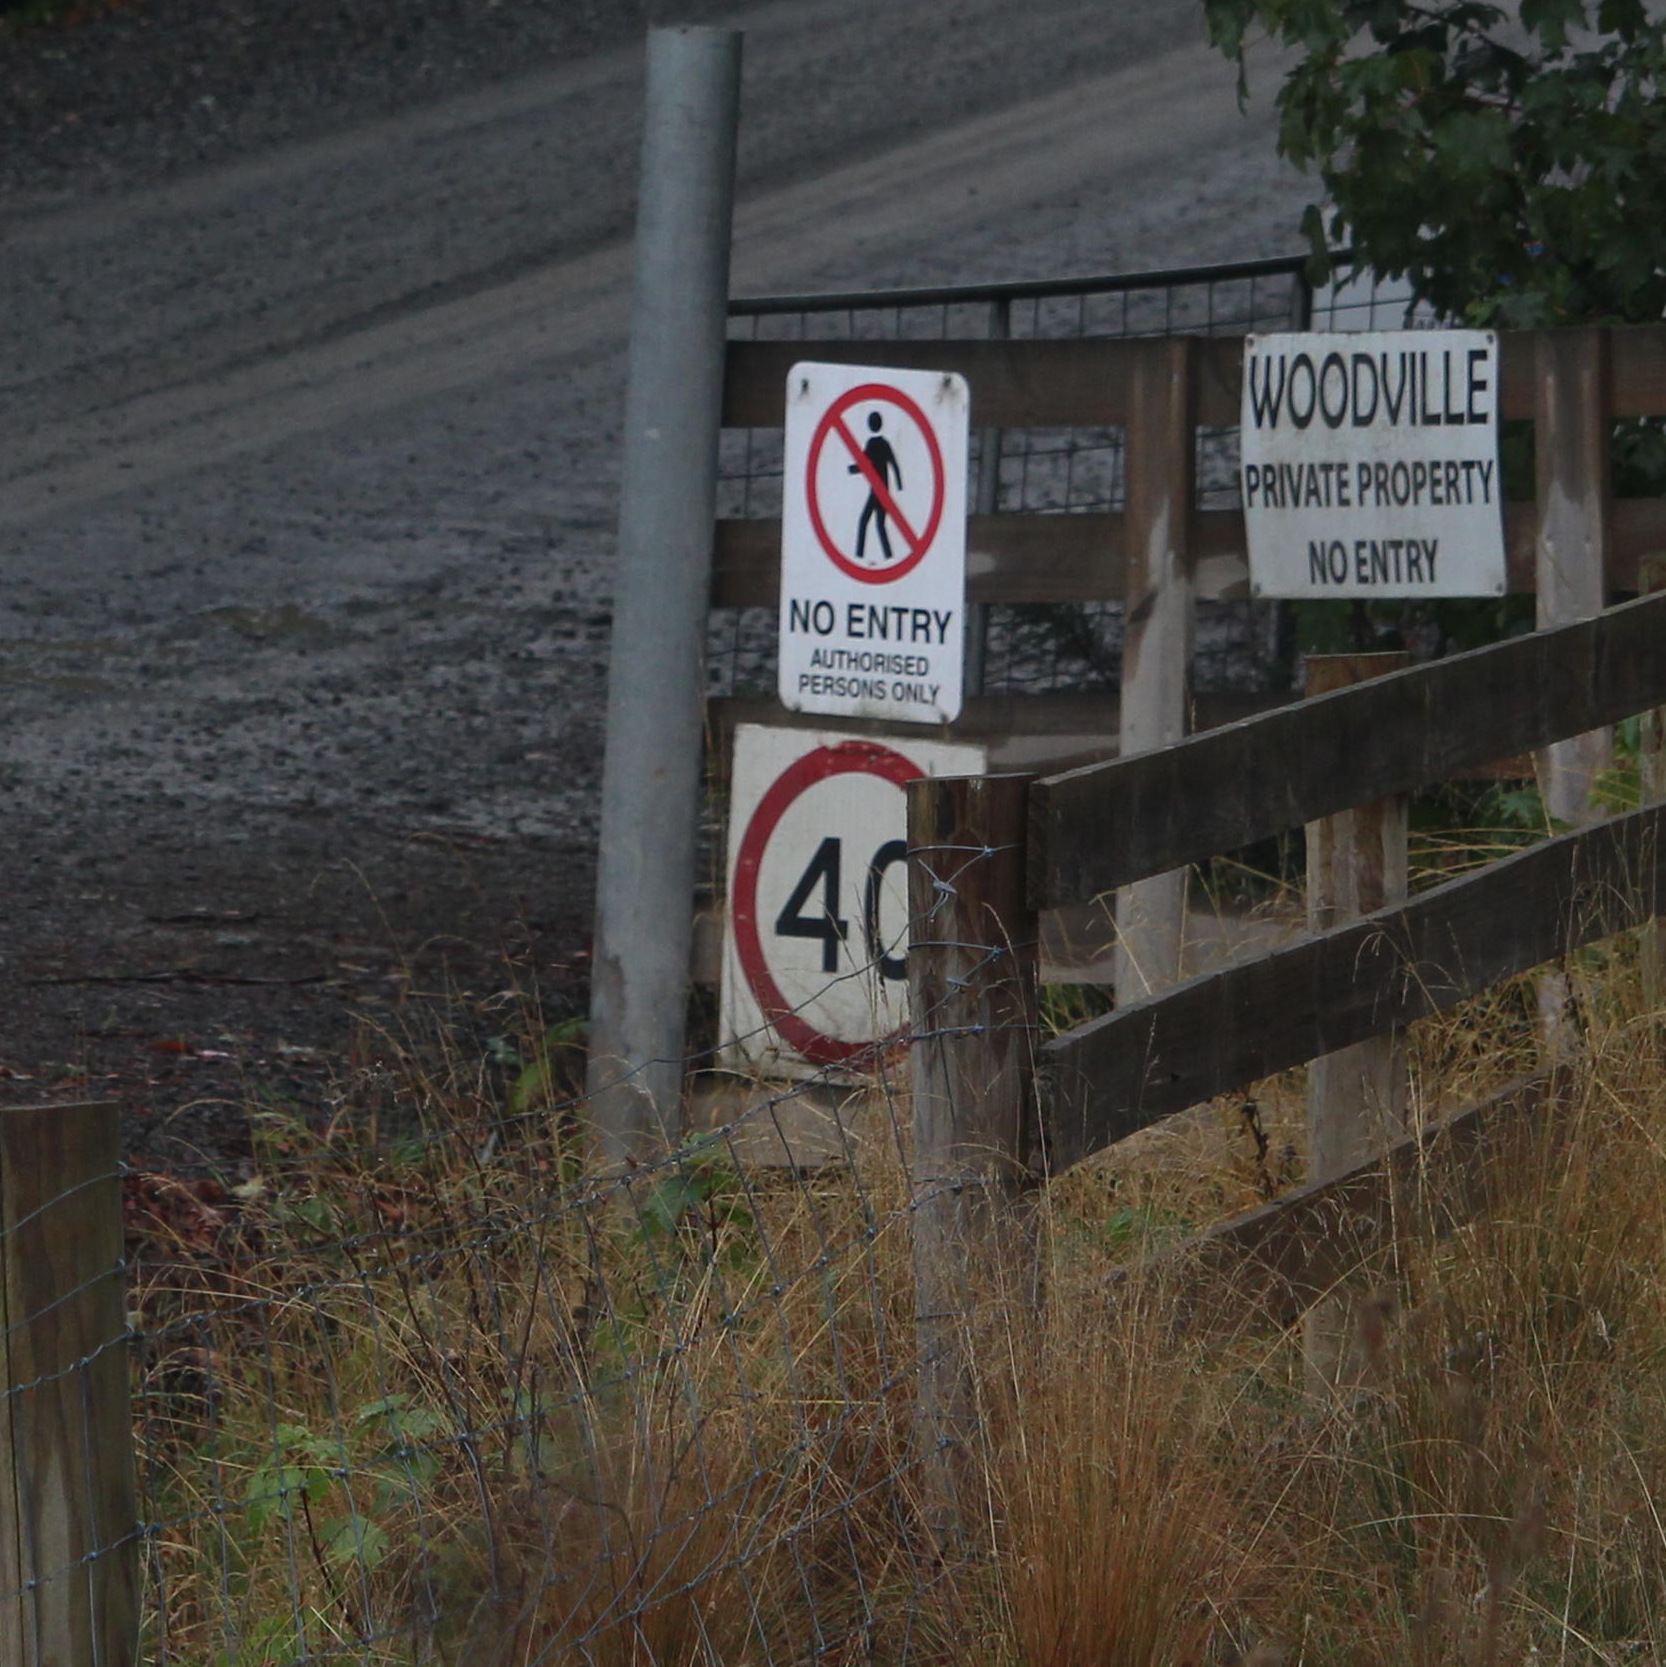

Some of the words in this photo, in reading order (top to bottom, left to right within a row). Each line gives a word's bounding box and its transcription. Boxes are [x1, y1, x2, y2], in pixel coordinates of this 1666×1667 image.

[1249, 349, 1489, 430] WOODVILLE
[1246, 462, 1351, 509] PRIVATE
[1358, 460, 1494, 507] PROPERTY
[1309, 540, 1348, 584] NO
[1355, 539, 1439, 584] ENTRY
[790, 598, 835, 636] NO
[847, 603, 952, 644] ENTRY
[810, 648, 930, 676] AUTHORISED
[799, 673, 886, 700] PERSONS
[891, 681, 941, 705] ONLY
[775, 836, 908, 980] 40
